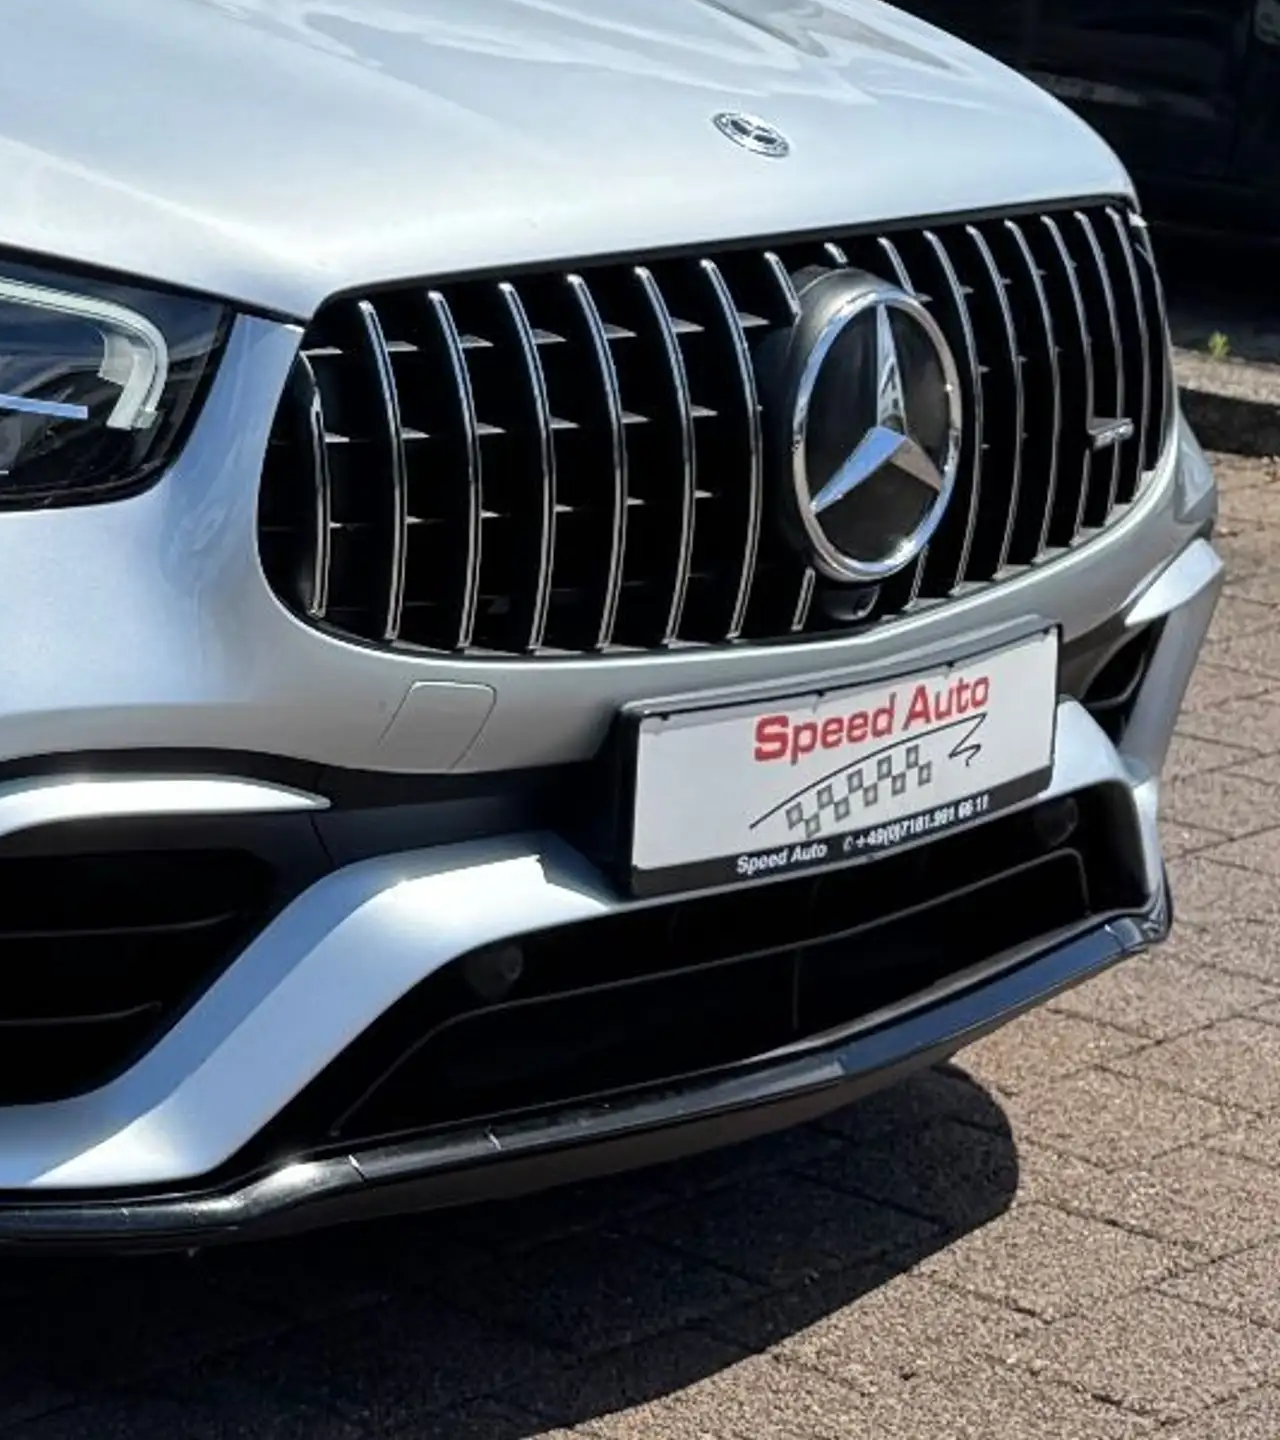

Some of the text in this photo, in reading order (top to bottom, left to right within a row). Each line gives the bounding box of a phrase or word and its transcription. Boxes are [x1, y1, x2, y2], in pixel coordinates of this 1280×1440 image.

[754, 675, 990, 766] Speed Auto
[736, 846, 789, 876] Speed
[790, 842, 829, 863] Auto
